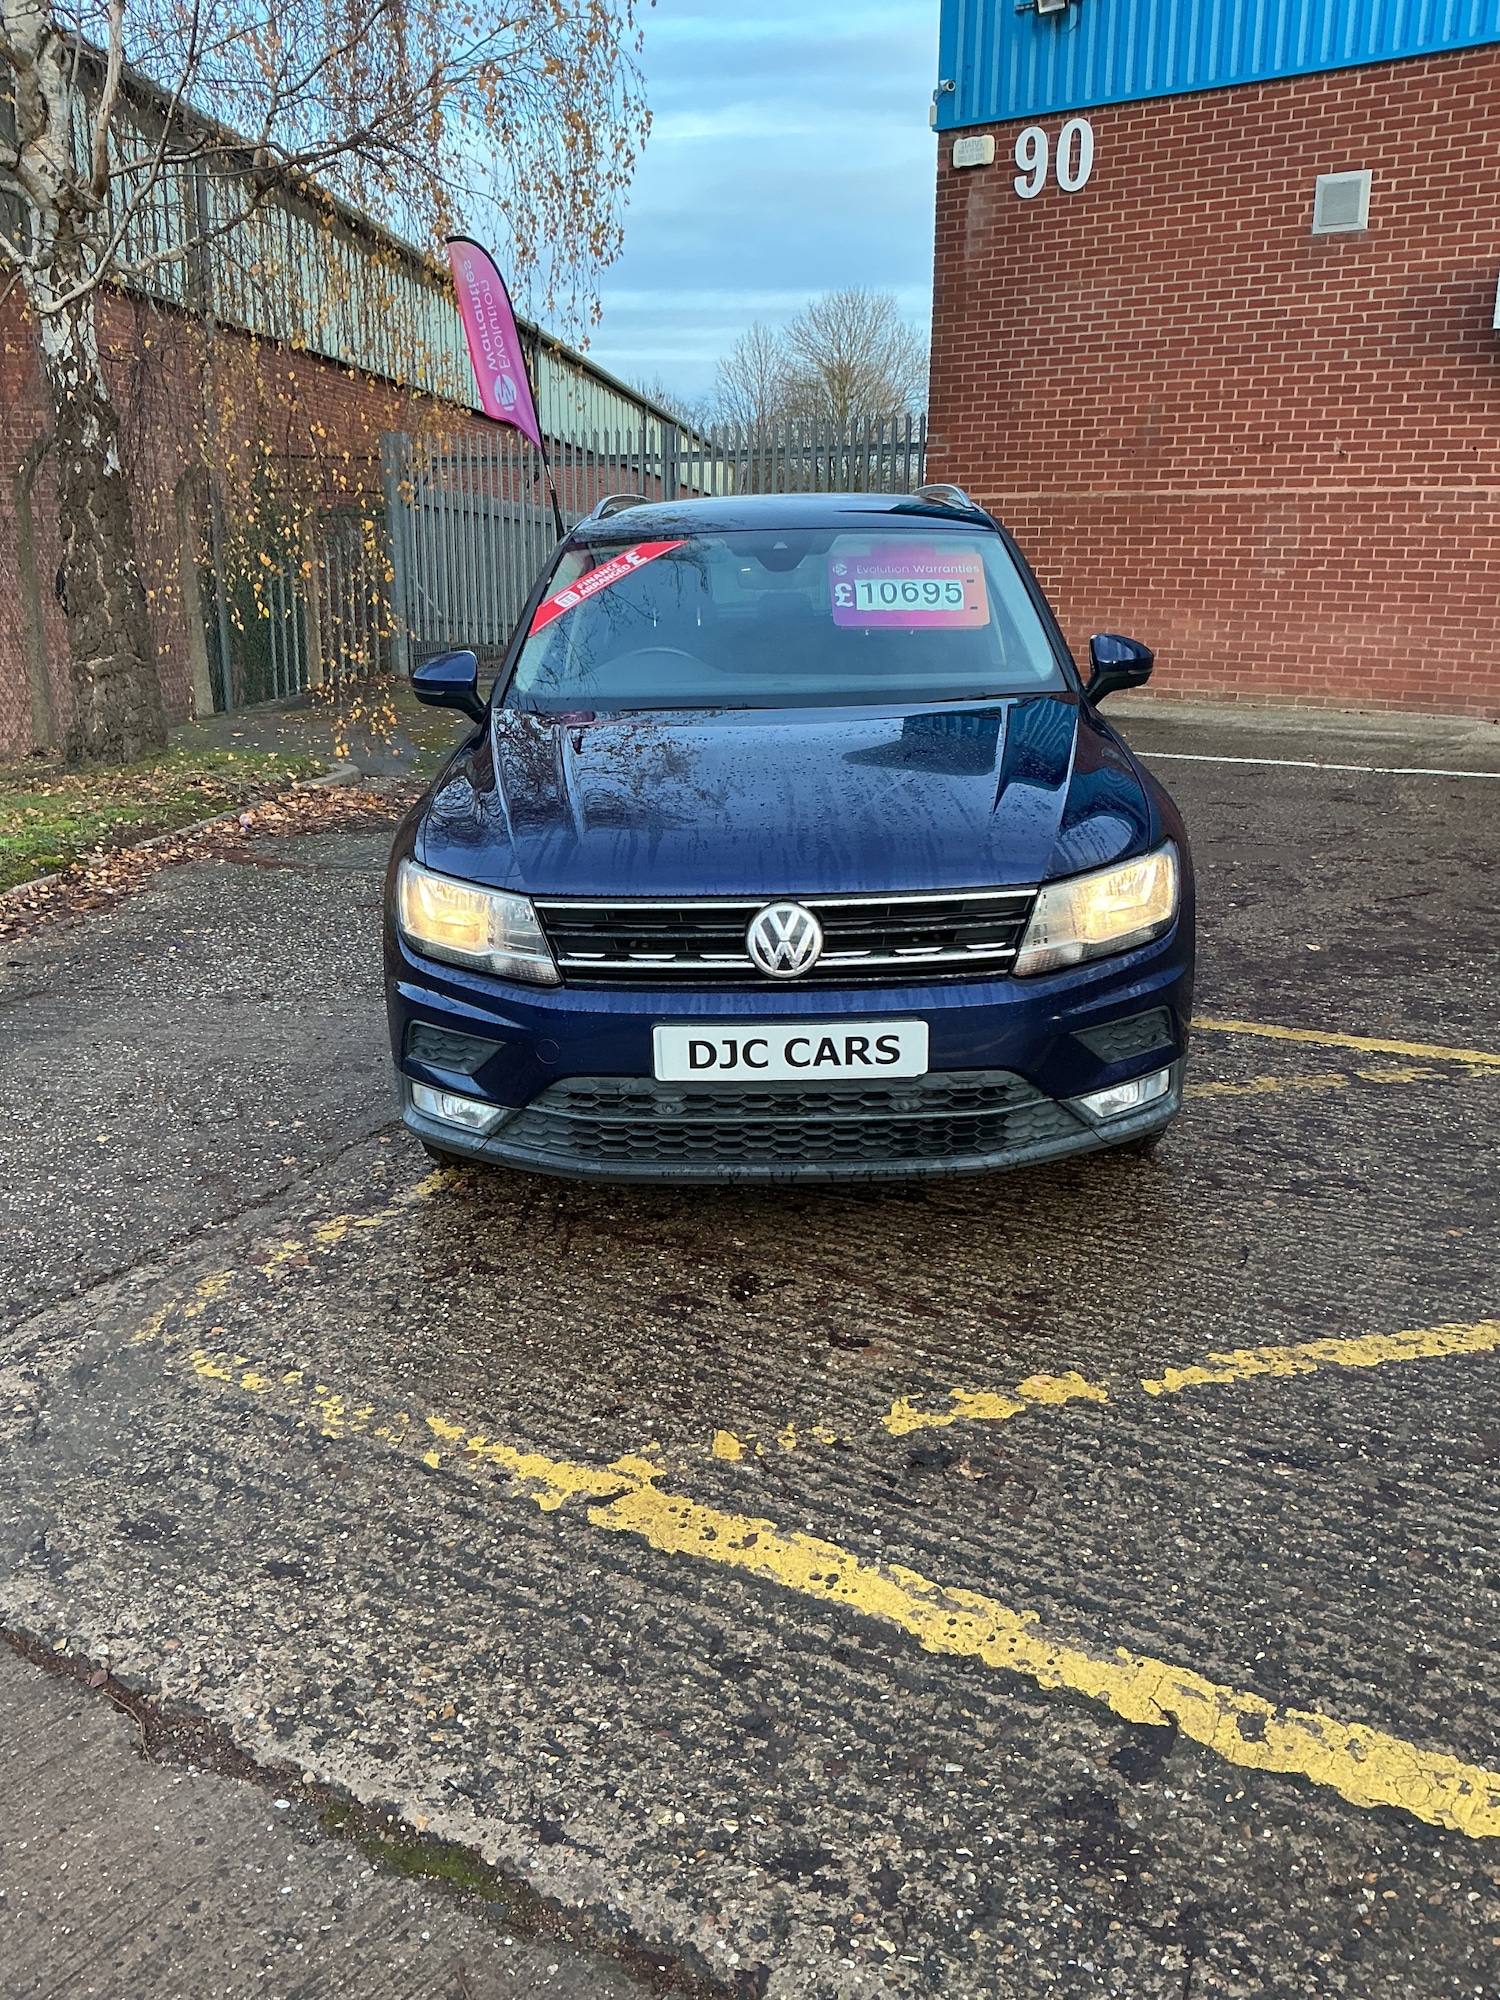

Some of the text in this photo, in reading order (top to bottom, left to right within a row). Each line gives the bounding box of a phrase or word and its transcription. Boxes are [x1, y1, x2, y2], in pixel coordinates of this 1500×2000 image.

[1014, 117, 1094, 199] 90
[577, 562, 622, 590] FINANCE
[579, 564, 631, 596] ARRANGED
[856, 563, 980, 575] Evolution Warranties
[688, 1034, 900, 1069] DJC CARS
